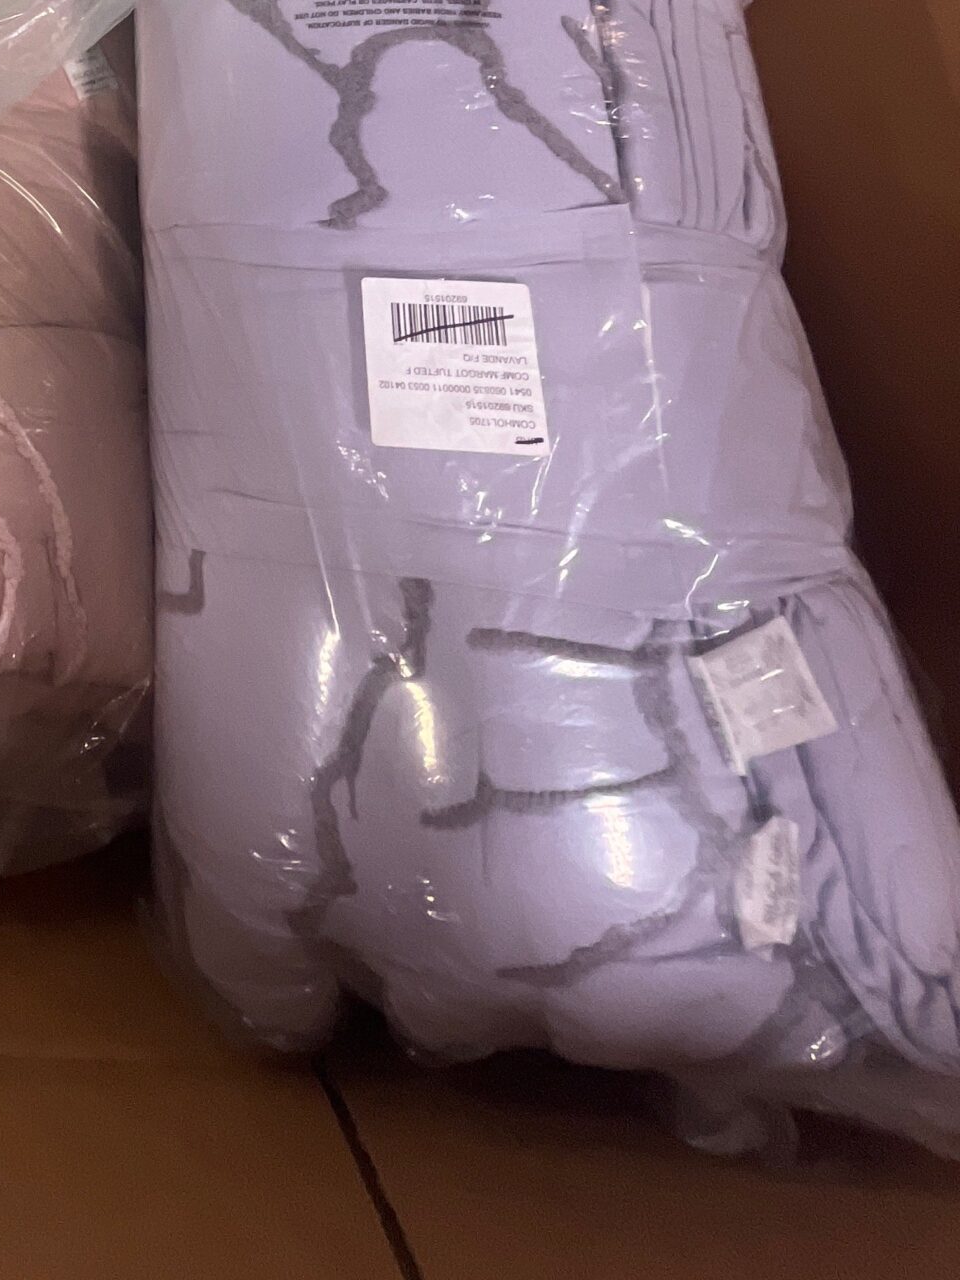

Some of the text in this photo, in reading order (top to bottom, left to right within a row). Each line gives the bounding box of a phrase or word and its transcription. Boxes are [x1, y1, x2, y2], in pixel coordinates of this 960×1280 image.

[482, 354, 528, 365] LAVANDE
[414, 366, 451, 376] TUFTED
[432, 382, 470, 393] 0000011
[510, 386, 532, 396] 0541
[512, 404, 534, 413] SKU
